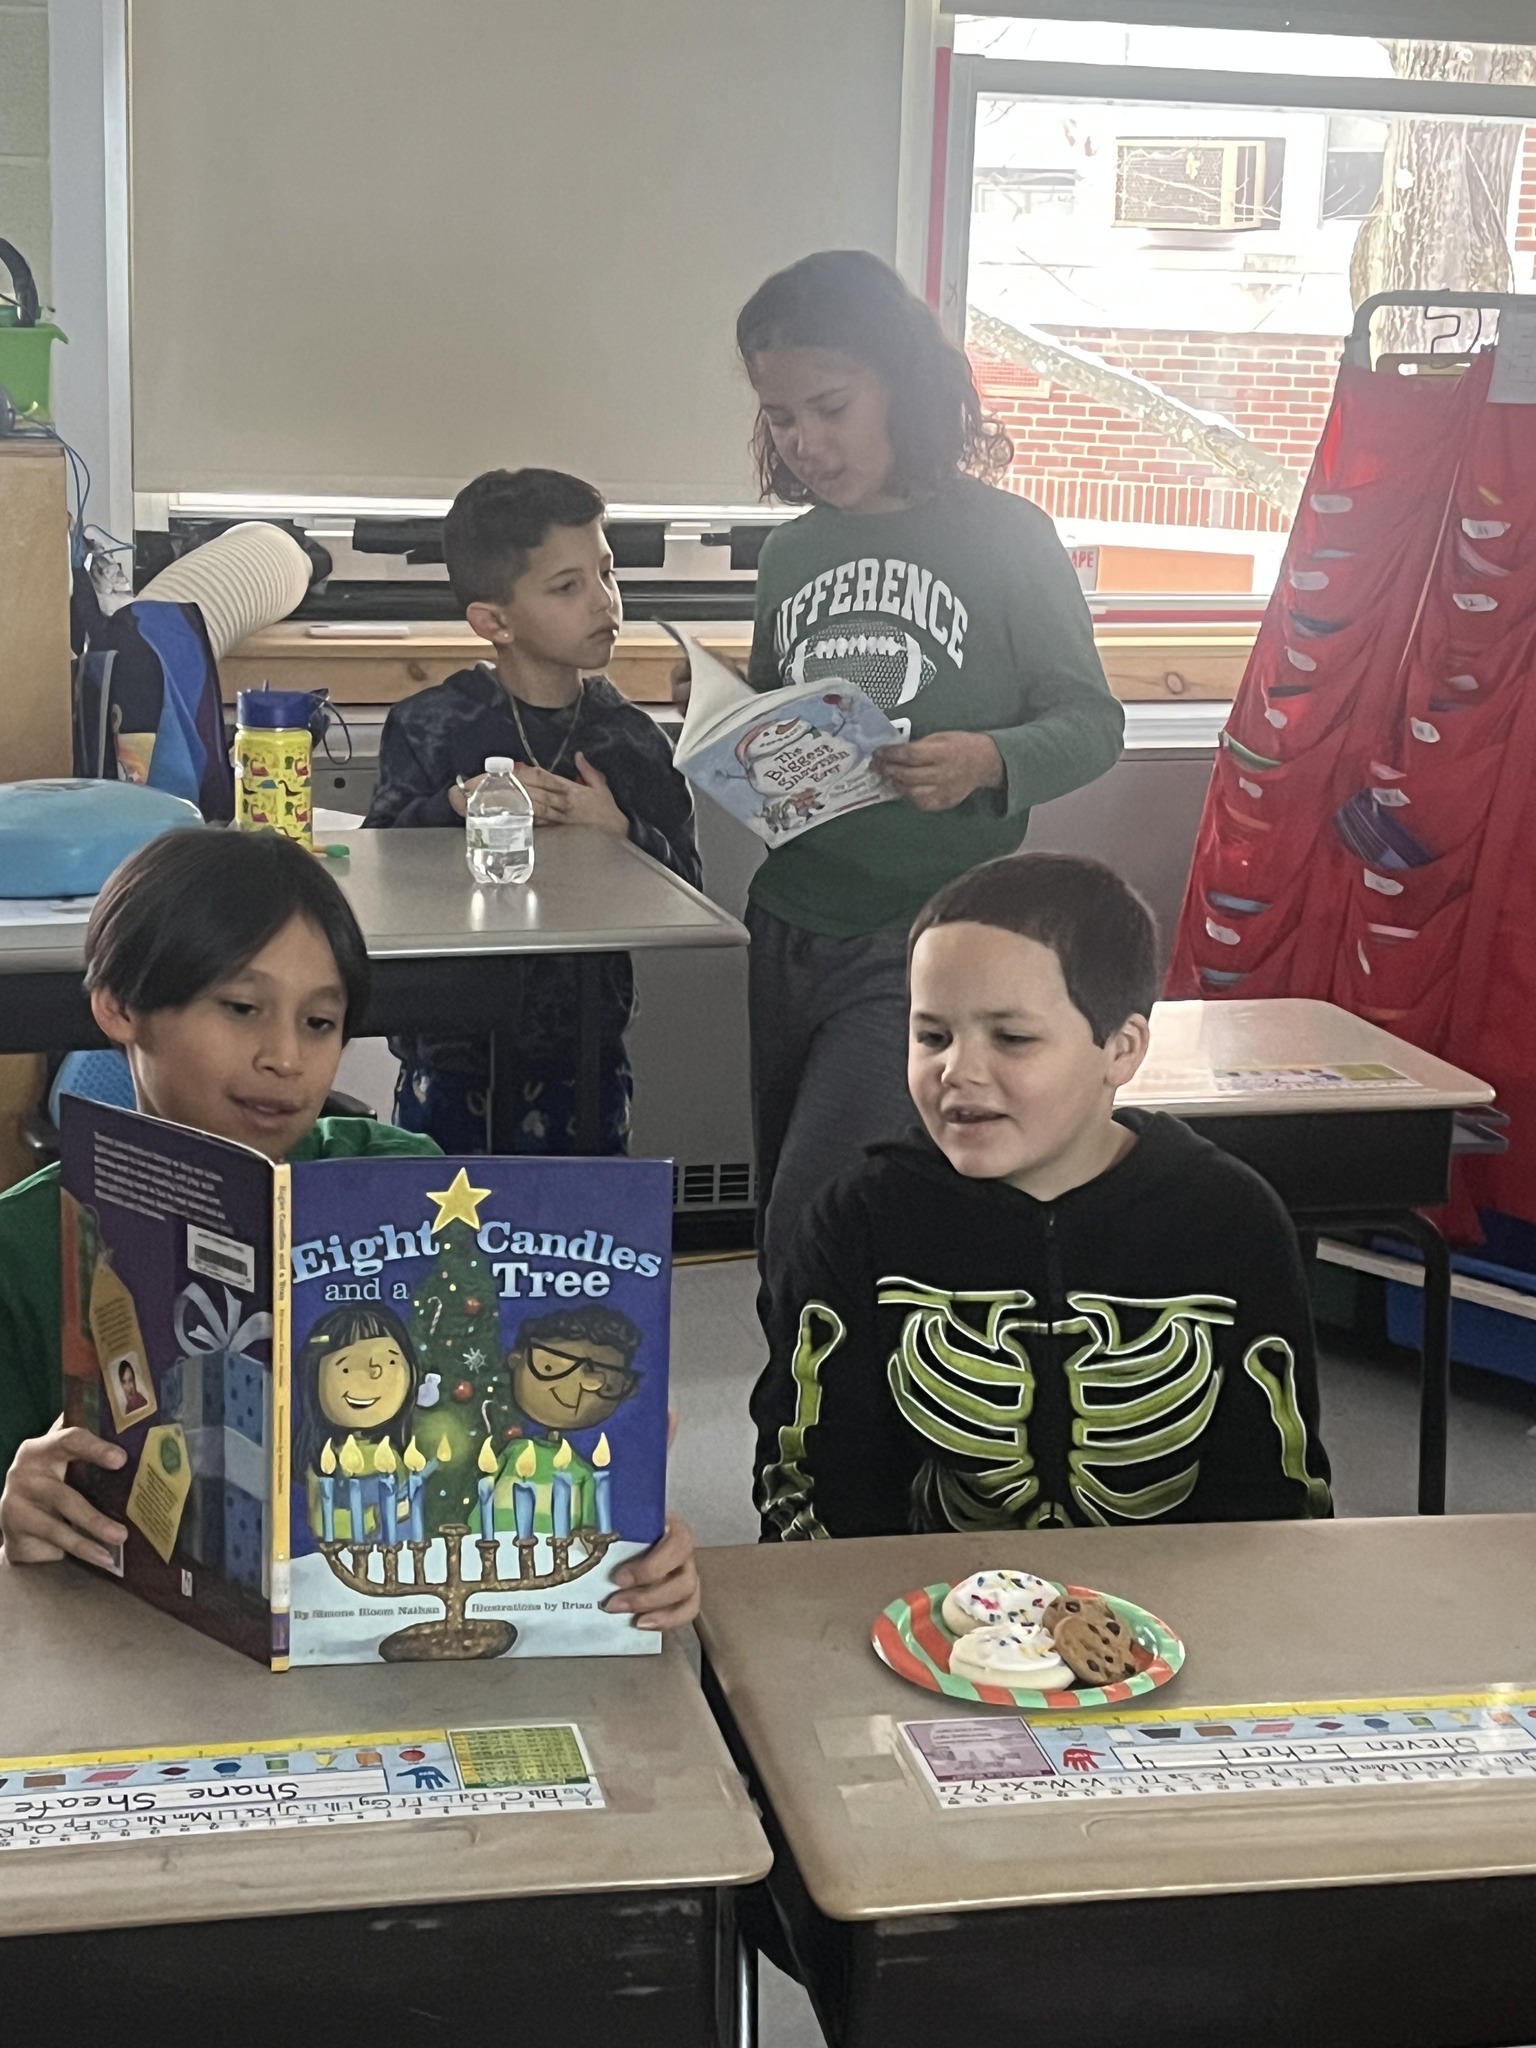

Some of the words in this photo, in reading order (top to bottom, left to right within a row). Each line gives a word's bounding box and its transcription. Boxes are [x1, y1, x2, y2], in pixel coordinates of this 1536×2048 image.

[763, 744, 834, 781] Biggest
[773, 747, 803, 764] The
[777, 750, 850, 791] Snowman
[809, 764, 842, 783] Ever
[291, 1220, 440, 1284] Eight
[476, 1221, 662, 1278] Candles
[325, 1278, 382, 1301] and
[393, 1281, 410, 1300] a
[492, 1262, 611, 1298] Tree
[294, 1610, 309, 1620] By
[544, 1602, 558, 1612] by
[1364, 1736, 1480, 1755] Steven
[185, 1781, 299, 1801] Shane
[13, 1791, 156, 1820] Sheafe
[62, 1816, 91, 1832] Pp
[136, 1814, 167, 1826] Nn
[171, 1810, 212, 1822] Mm
[15, 1820, 56, 1835] Qq
